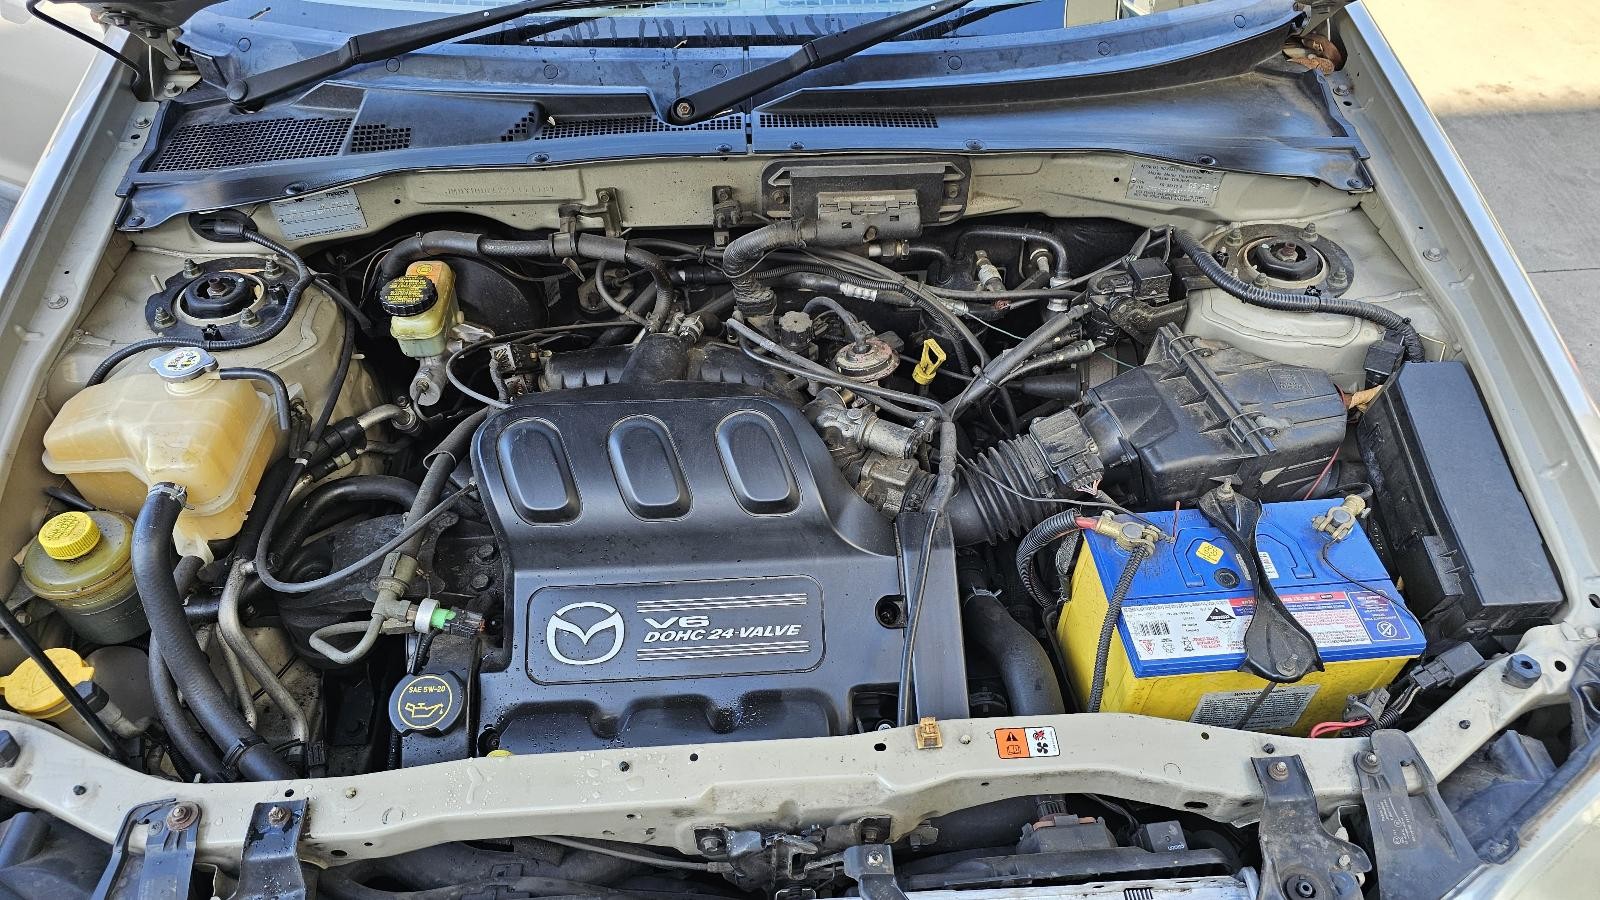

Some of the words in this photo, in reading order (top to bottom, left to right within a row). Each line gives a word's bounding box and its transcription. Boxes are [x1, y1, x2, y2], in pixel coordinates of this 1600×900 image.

[643, 615, 710, 629] V6
[643, 629, 706, 643] DOHC
[707, 624, 802, 640] 24-VALVE
[423, 685, 446, 693] 5W-20
